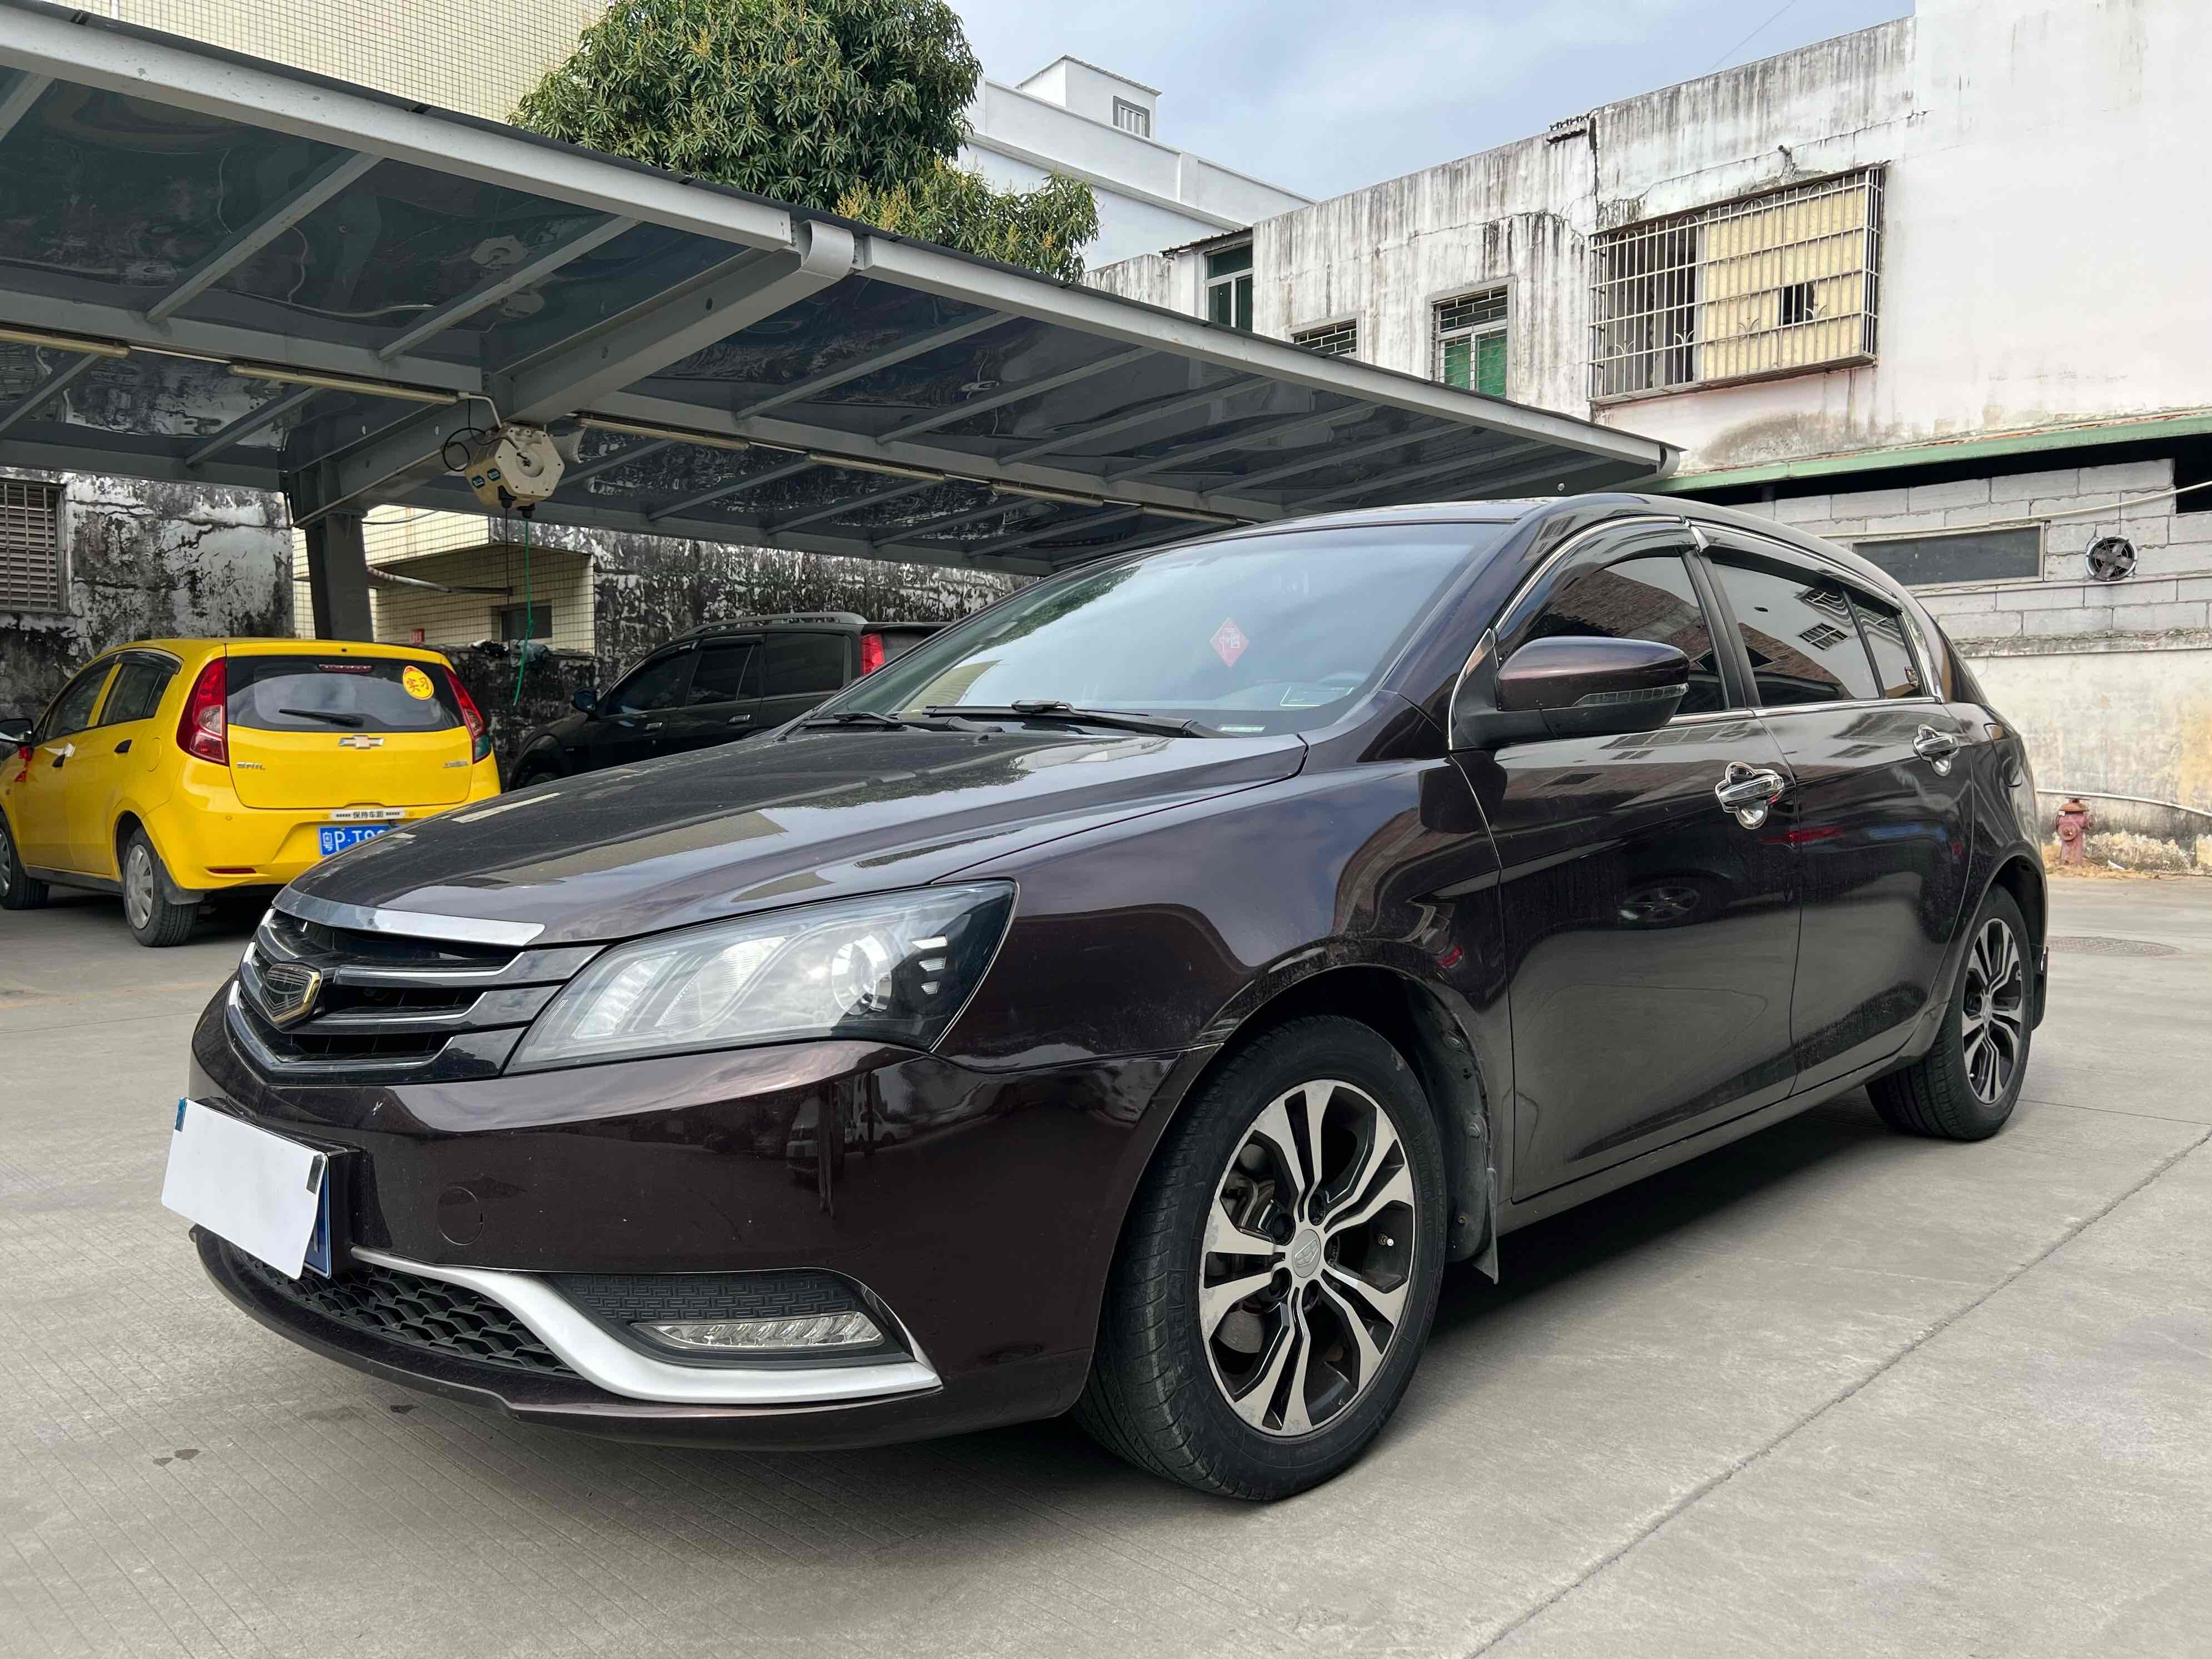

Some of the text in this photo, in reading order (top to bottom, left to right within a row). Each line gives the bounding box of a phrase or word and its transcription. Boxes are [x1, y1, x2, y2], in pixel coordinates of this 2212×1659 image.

[406, 677, 430, 693] 实习
[353, 811, 384, 819] 保持车距
